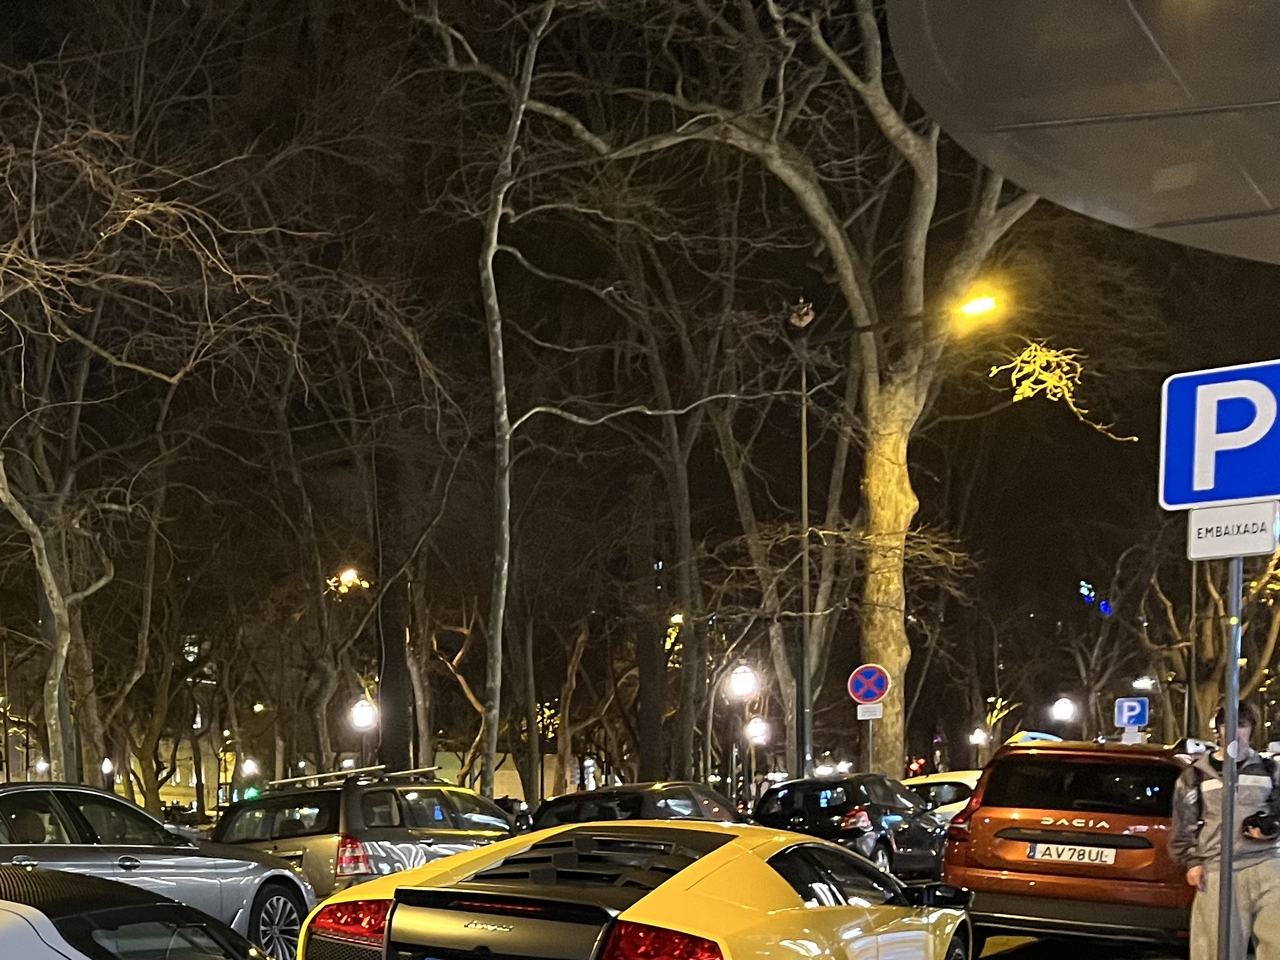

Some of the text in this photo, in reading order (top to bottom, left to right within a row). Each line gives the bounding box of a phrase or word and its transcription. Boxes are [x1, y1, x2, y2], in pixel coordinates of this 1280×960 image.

[1192, 379, 1278, 491] P
[1197, 521, 1268, 539] EMBAIXADA
[1122, 701, 1142, 724] P
[1040, 816, 1111, 829] DACIA
